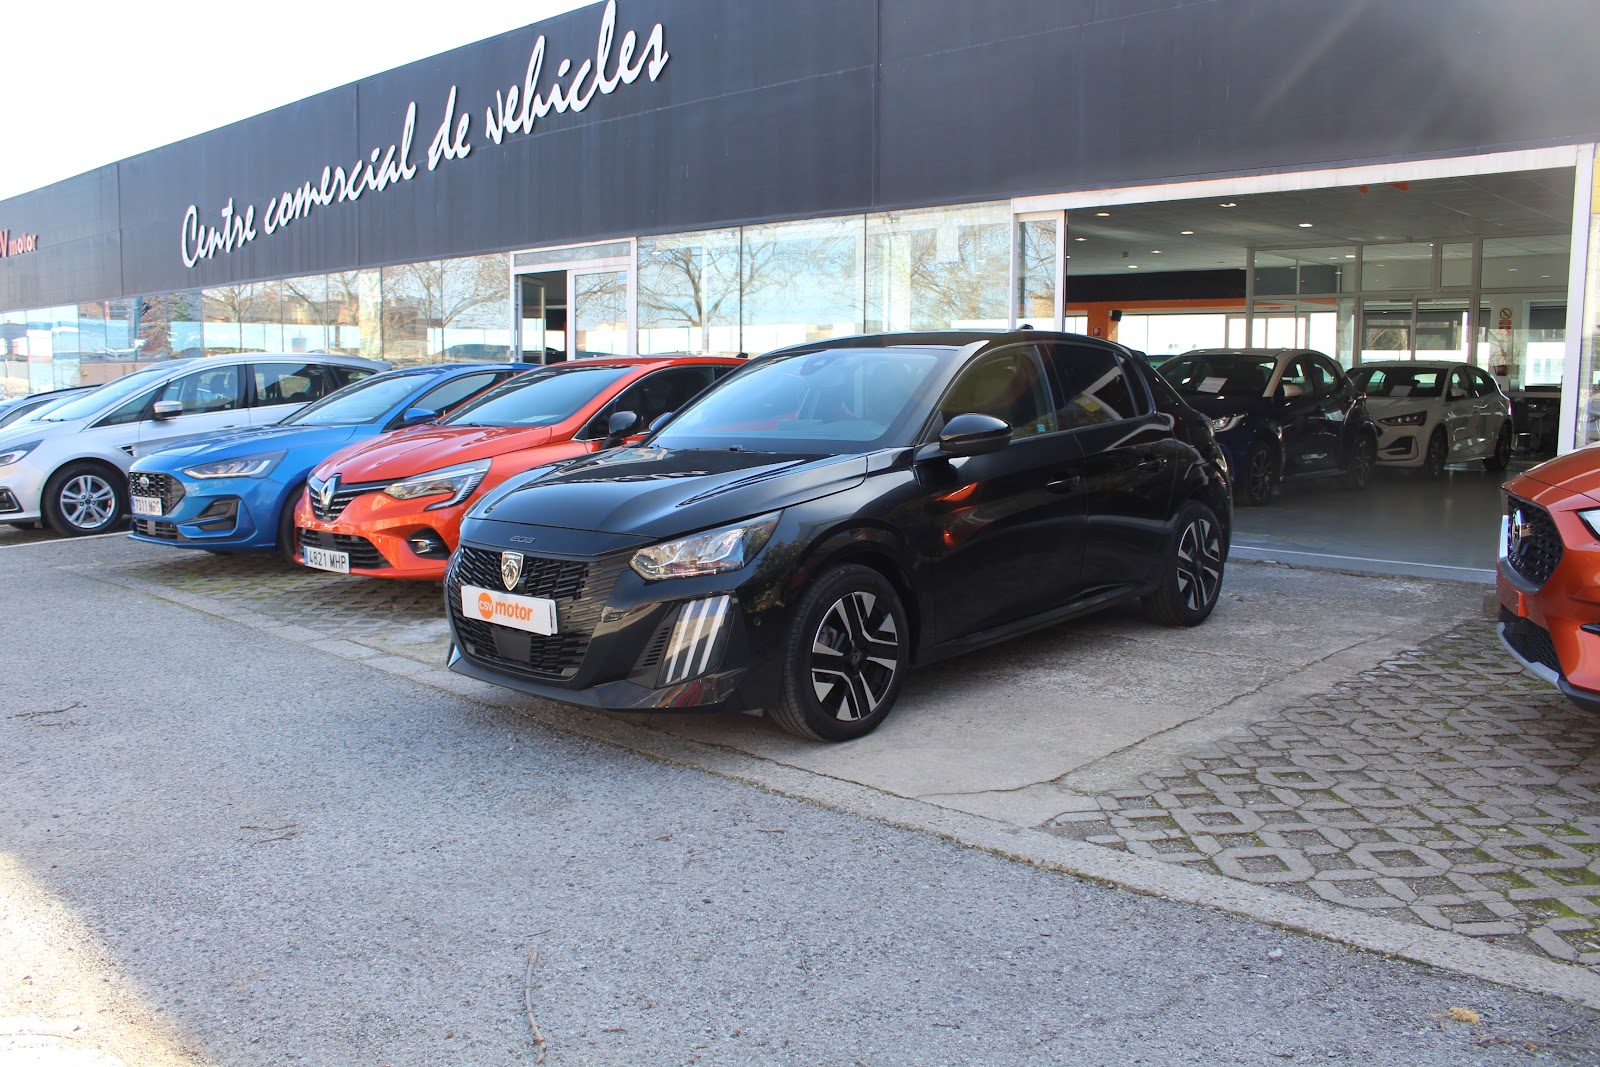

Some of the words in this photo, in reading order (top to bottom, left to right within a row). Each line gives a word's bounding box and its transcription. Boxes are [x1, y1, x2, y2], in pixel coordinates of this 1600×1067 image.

[182, 197, 257, 268] Centre
[264, 101, 417, 235] comercial
[428, 85, 471, 171] de
[486, 0, 670, 145] vehicles
[9, 232, 37, 256] motor
[309, 550, 327, 568] 4821
[329, 553, 347, 570] MHP
[479, 600, 493, 612] CSV
[495, 601, 533, 621] motor
